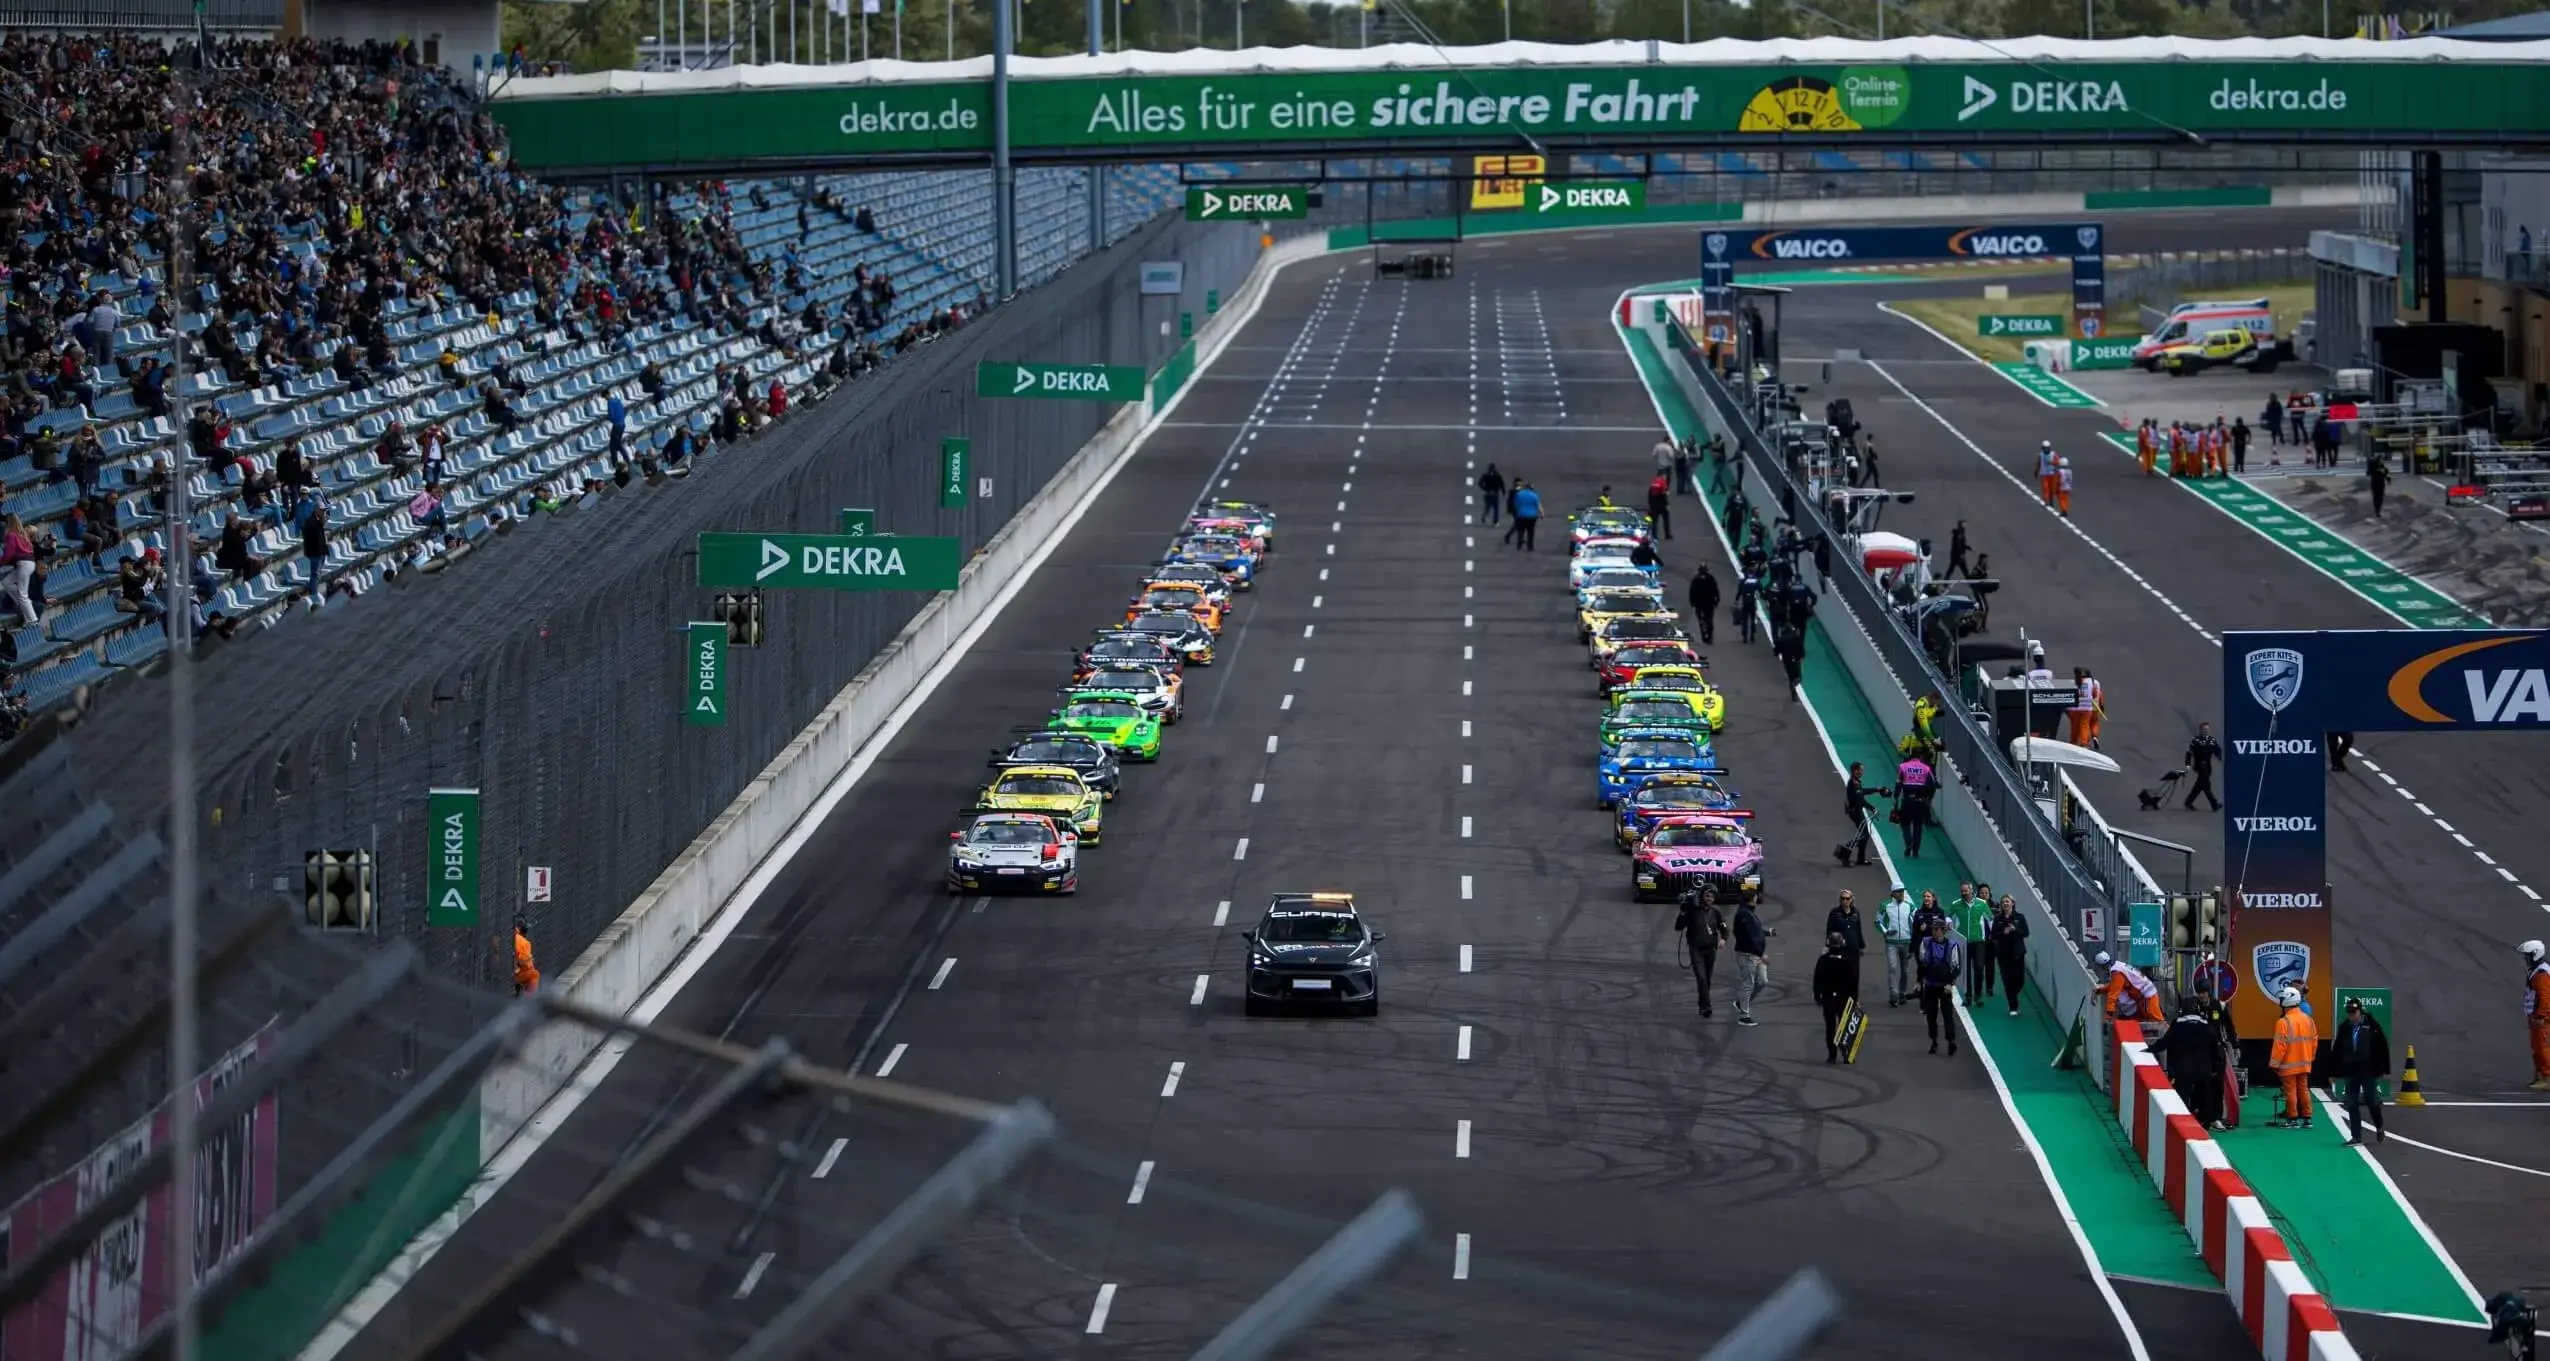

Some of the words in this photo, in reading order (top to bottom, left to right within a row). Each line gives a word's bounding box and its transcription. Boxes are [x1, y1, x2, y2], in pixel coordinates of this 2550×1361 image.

[1844, 76, 1902, 91] Online-
[1794, 91, 1809, 106] 12
[1849, 92, 1898, 107] Termin
[2012, 81, 2129, 112] DEKRA
[2210, 78, 2347, 110] dekra.de
[1087, 89, 1186, 132] Alles
[1199, 87, 1255, 130] für
[1270, 91, 1355, 128] eine
[1370, 82, 1550, 127] sichere
[1564, 79, 1699, 122] Fahrt
[840, 99, 978, 133] dekra.de
[1228, 194, 1293, 212] DEKRA
[1567, 188, 1631, 207] DEKRA
[2009, 318, 2053, 333] DEKRA
[1042, 370, 1110, 392] DEKRA
[951, 451, 962, 482] DEKRA
[802, 546, 907, 576] DEKRA
[700, 638, 716, 690] DEKRA
[2249, 651, 2275, 663] EXPERT
[2233, 739, 2317, 754] VIEROL
[2233, 816, 2317, 832] VIEROL
[445, 812, 463, 880] DEKRA
[1670, 858, 1729, 868] BWT
[2240, 893, 2323, 909] VIEROL
[1271, 911, 1354, 919] CUPRA
[2257, 944, 2282, 955] EXPERT
